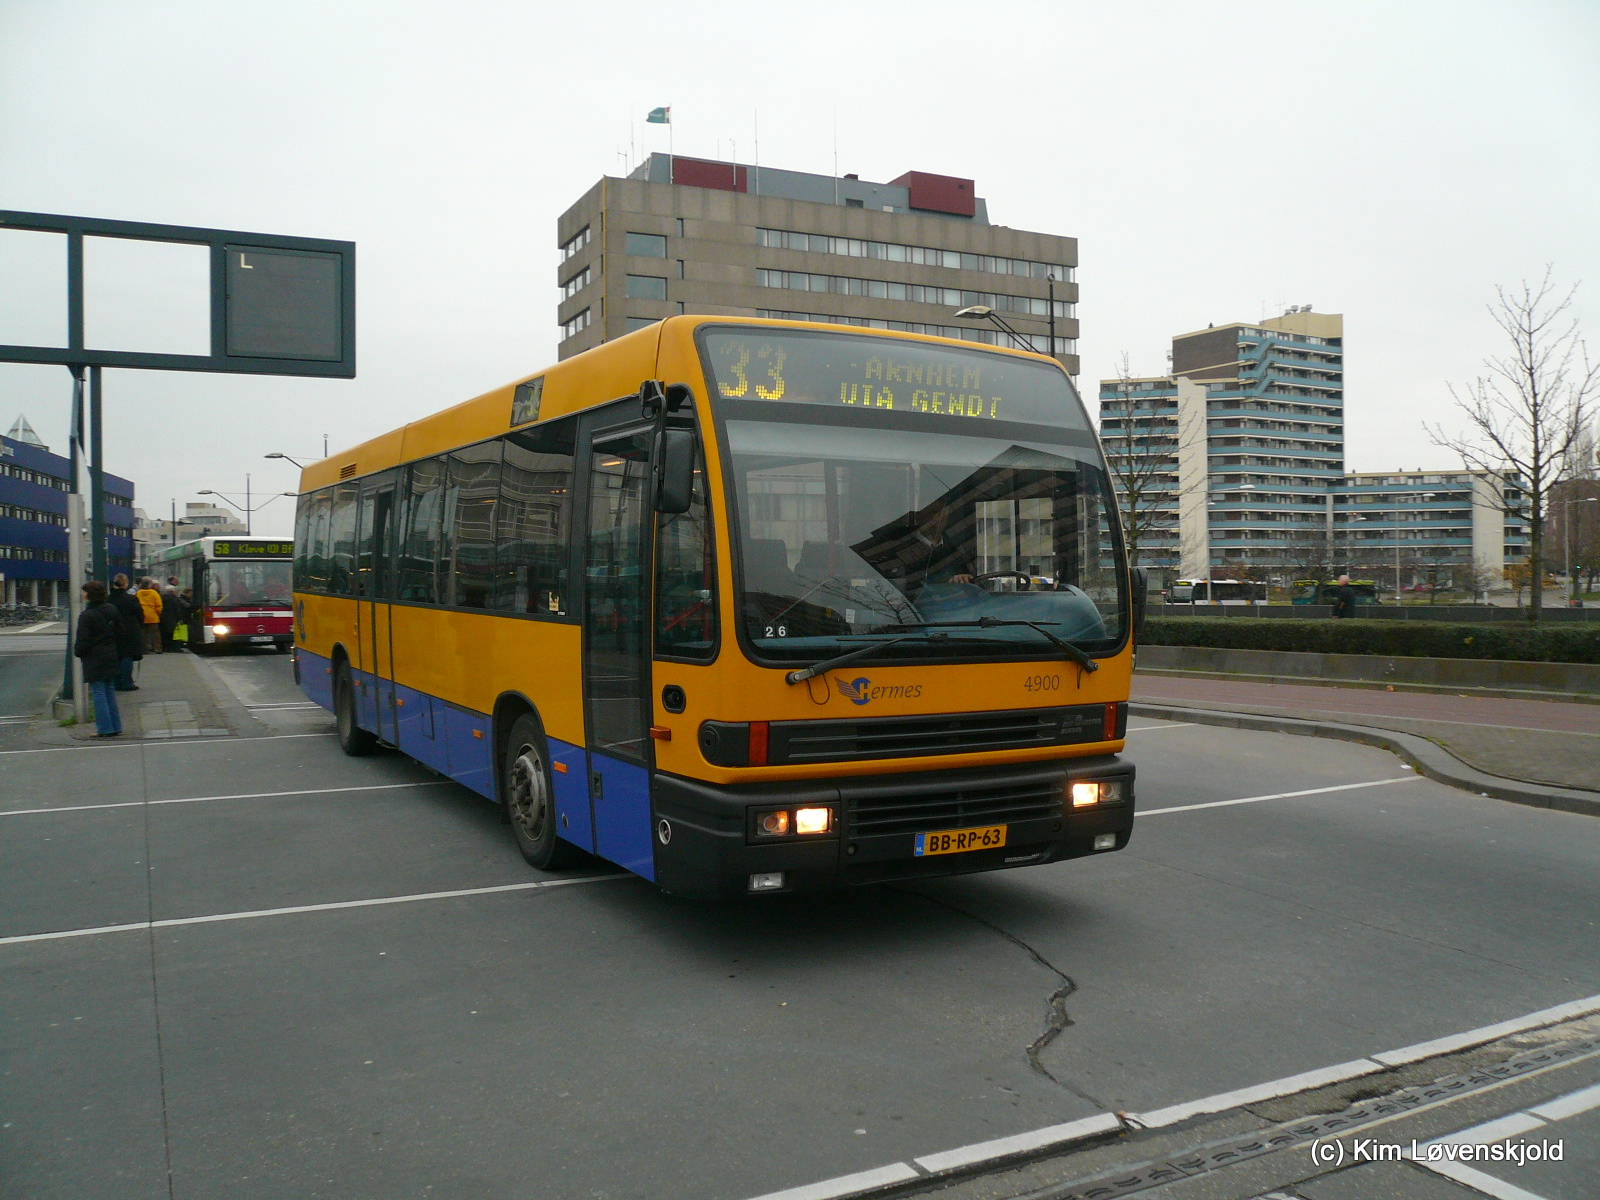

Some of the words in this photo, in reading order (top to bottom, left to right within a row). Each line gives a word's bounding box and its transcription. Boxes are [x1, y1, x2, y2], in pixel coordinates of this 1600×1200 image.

[241, 253, 253, 269] L
[718, 341, 786, 400] 33
[215, 543, 230, 554] 58
[238, 543, 265, 554] Kleve
[850, 677, 923, 706] Hermes
[1024, 675, 1060, 692] 4900
[929, 829, 1001, 852] BB-RP-63
